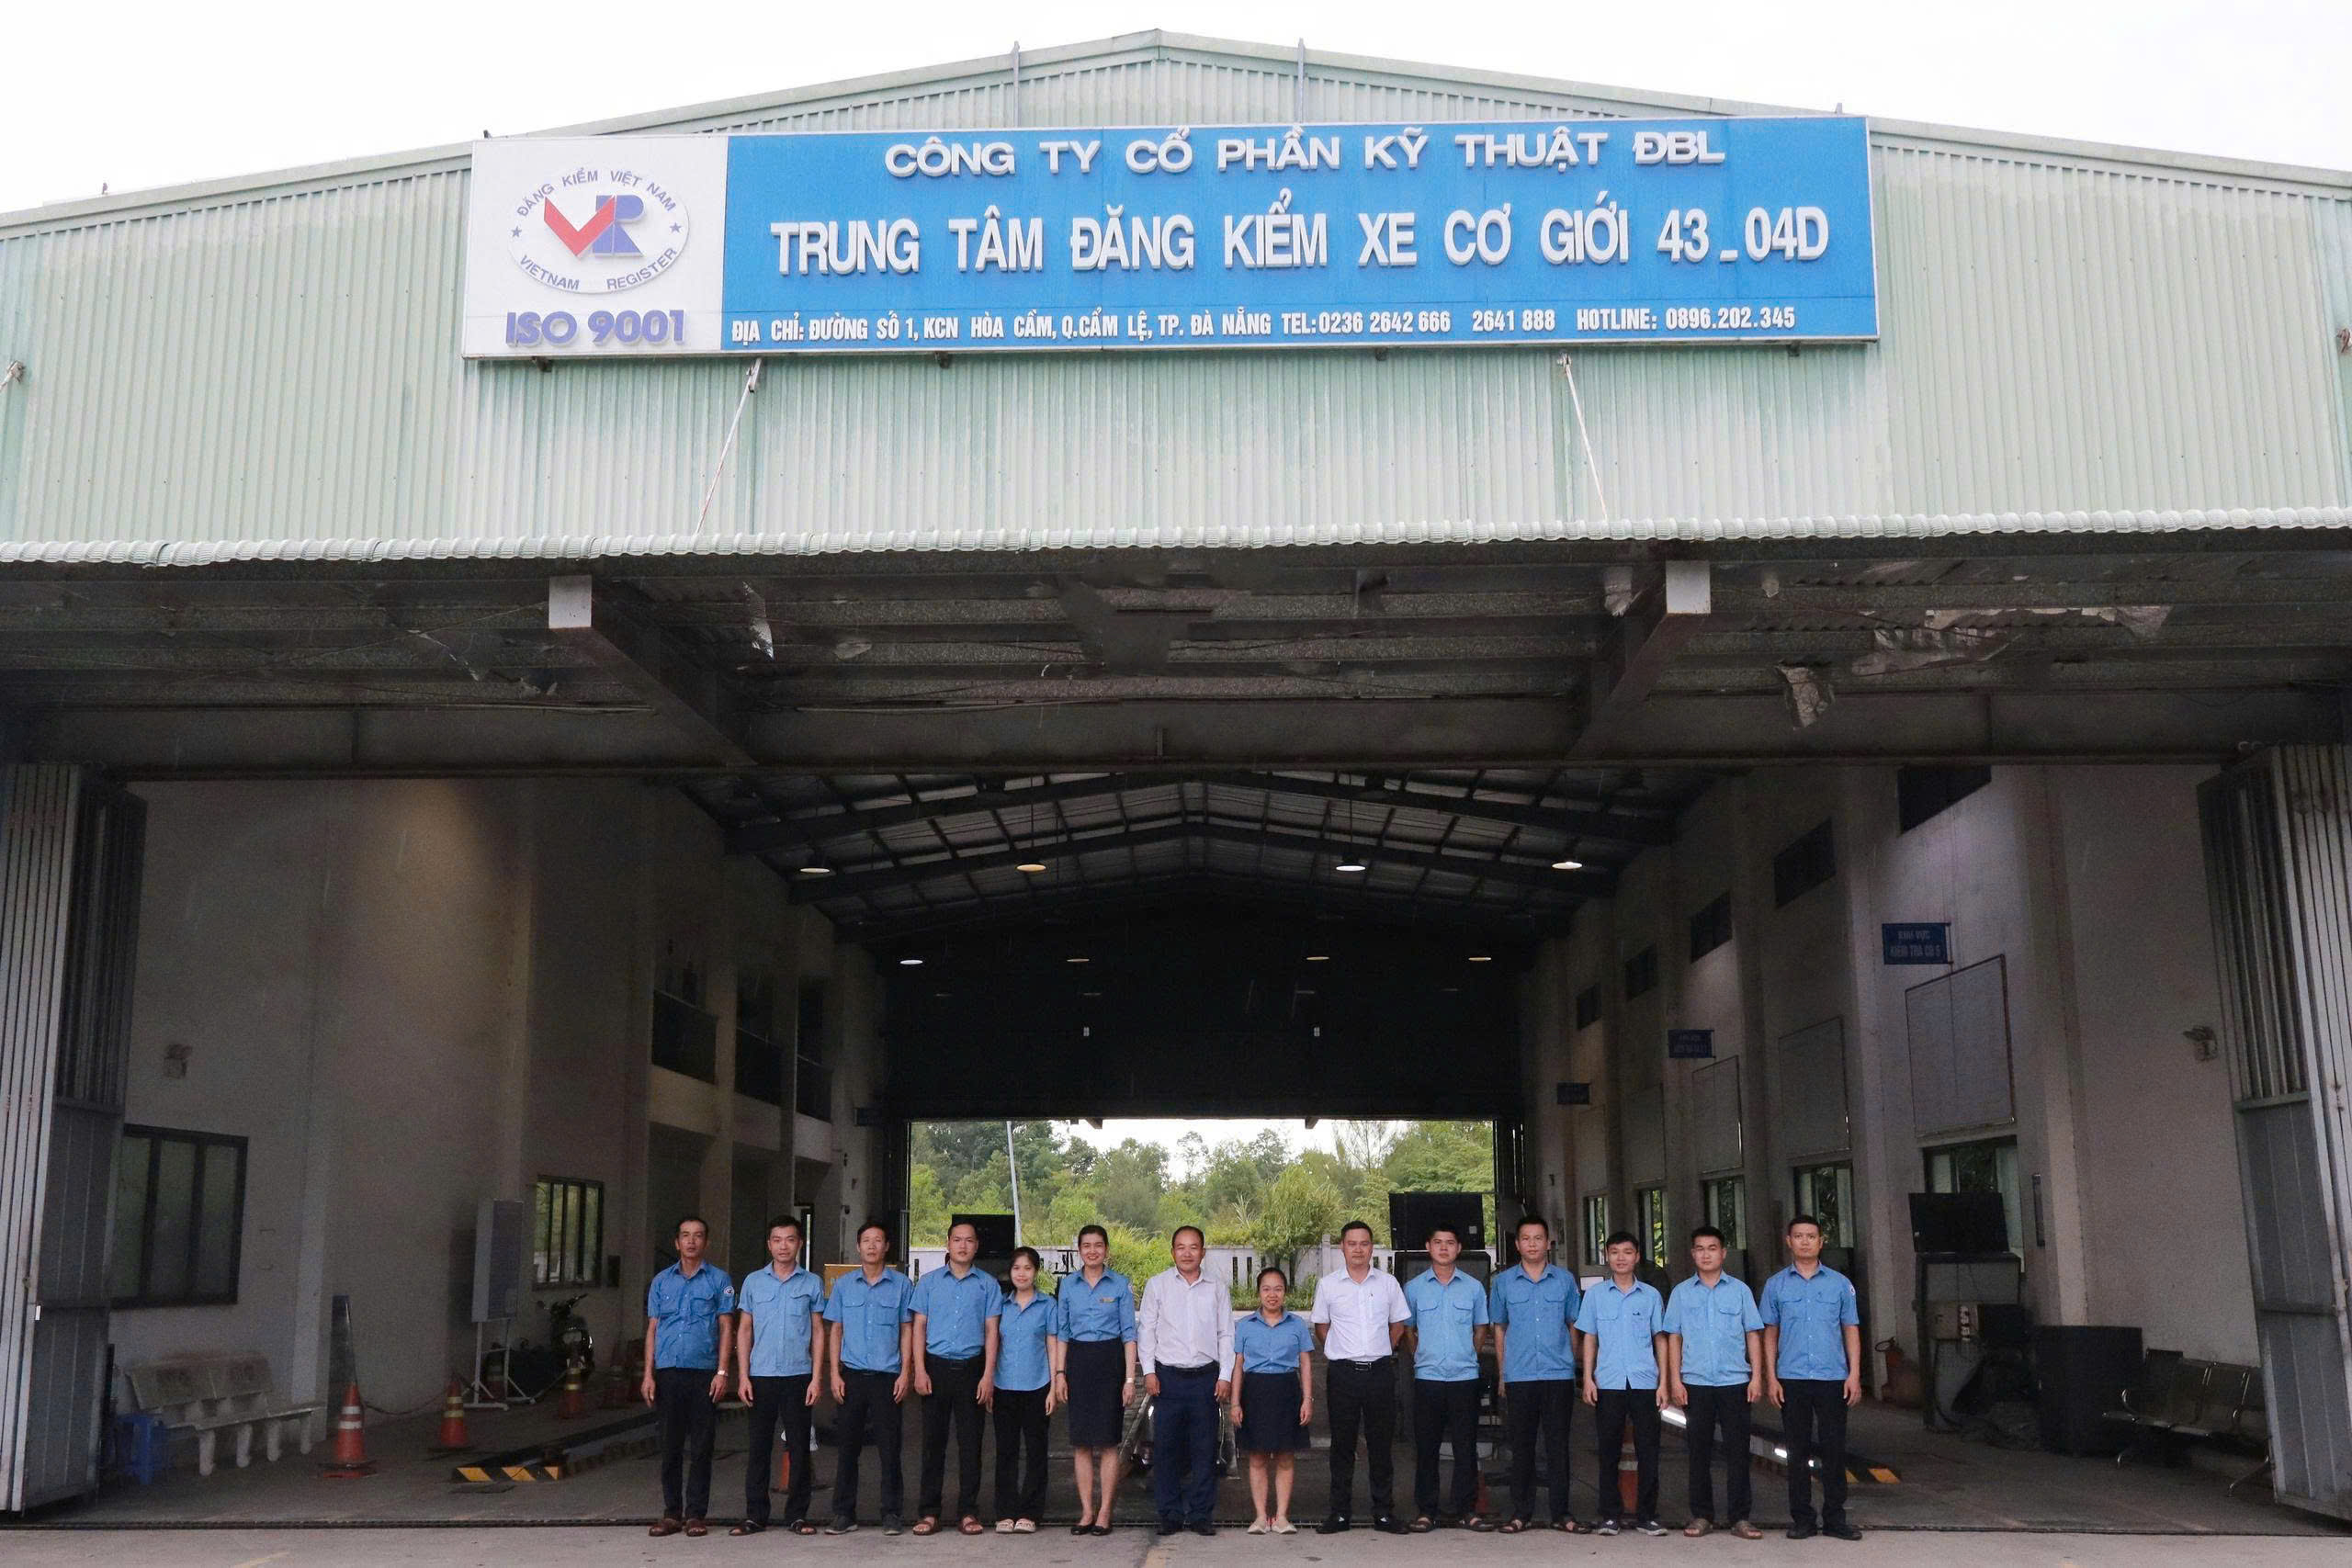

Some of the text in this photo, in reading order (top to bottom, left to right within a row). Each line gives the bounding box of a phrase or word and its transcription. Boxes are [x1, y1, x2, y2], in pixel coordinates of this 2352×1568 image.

[885, 136, 1015, 177] CÔNG
[1039, 140, 1101, 174] TY
[1125, 125, 1193, 174] CỔ
[1363, 127, 1428, 168] KỸ
[1454, 125, 1609, 172] THUẬT
[1632, 130, 1725, 165] ĐBL
[646, 183, 676, 212] NAM
[770, 219, 919, 276] TRUNG
[948, 205, 1043, 273] TÂM
[1070, 204, 1194, 271] ĐĂNG
[1223, 187, 1328, 268] KIỂM
[1358, 211, 1418, 266] XE
[1443, 202, 1512, 266] CƠ
[1540, 190, 1629, 265] GIỚI
[519, 247, 677, 291] VIETNAM REGISTER
[505, 308, 686, 346] ISO 9001
[731, 320, 761, 346] ĐỊA
[876, 310, 899, 340] SỐ
[905, 317, 919, 341] 1,
[923, 316, 958, 339] KCN
[970, 310, 1005, 338] HÒA
[1158, 314, 1183, 336] TP.
[1191, 310, 1214, 335] ĐÀ
[1369, 310, 1413, 333] 2642
[1418, 310, 1451, 333] 666
[1472, 310, 1515, 332] 2641
[1521, 309, 1555, 332] 888
[1577, 308, 1657, 331] HOTLINE:
[1665, 306, 1795, 331] 0896.202.345
